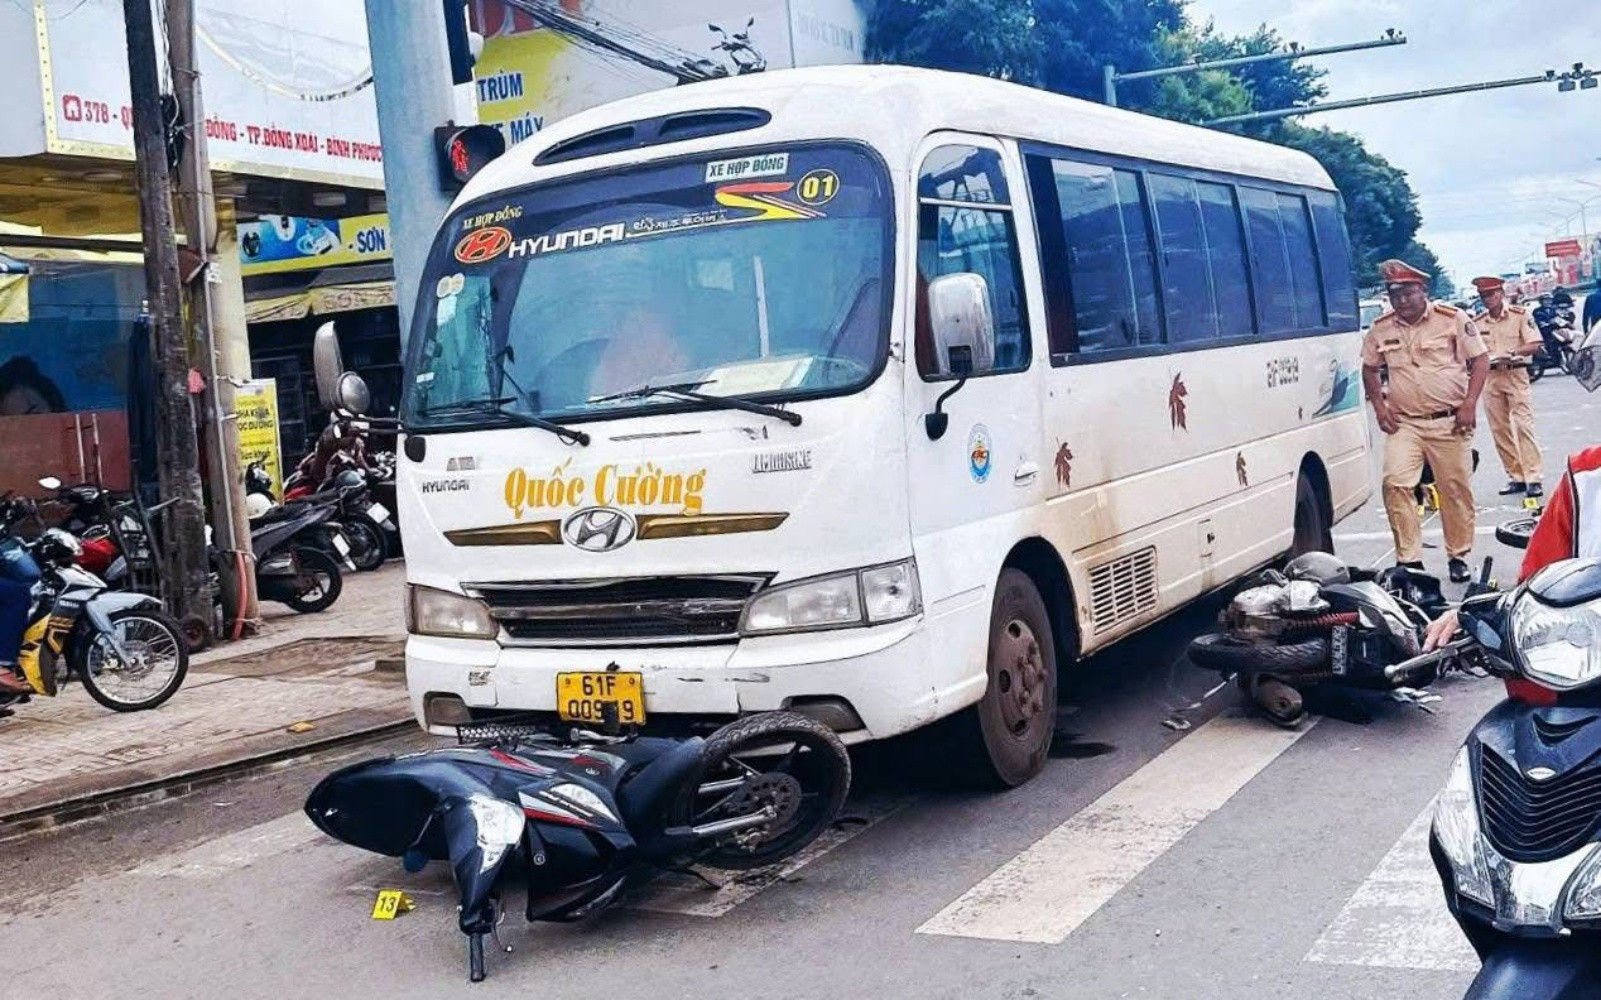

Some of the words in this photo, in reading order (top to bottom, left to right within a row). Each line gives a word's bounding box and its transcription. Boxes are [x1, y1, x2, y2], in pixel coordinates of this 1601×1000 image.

[478, 69, 524, 102] TRÙM
[84, 100, 110, 123] 378
[510, 111, 544, 145] MÁY
[709, 163, 724, 178] XE
[726, 161, 750, 176] HỢP
[803, 175, 834, 199] 01
[357, 226, 386, 253] SƠN
[508, 223, 626, 258] HYUNDAI
[422, 479, 470, 494] HYUNDAI
[505, 457, 585, 519] Quốc
[595, 462, 706, 517] Cường
[583, 675, 616, 696] 61F
[568, 699, 634, 720] 0099
[380, 896, 396, 912] 13
